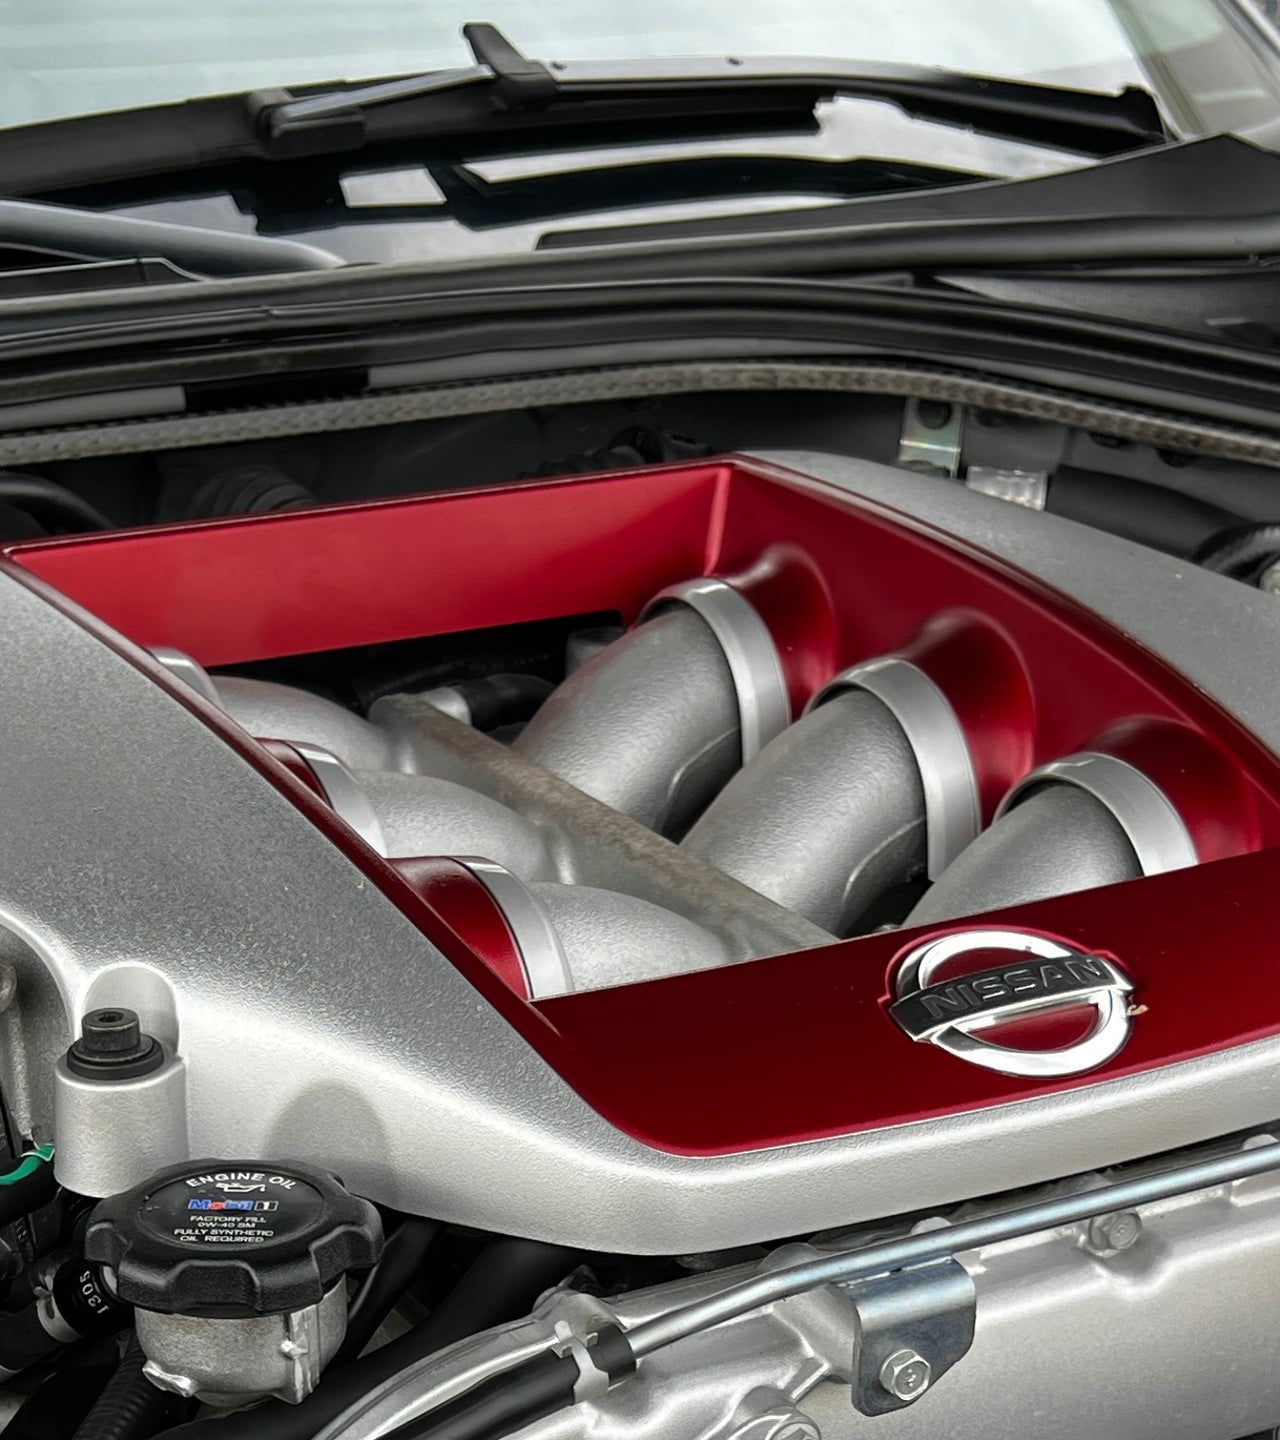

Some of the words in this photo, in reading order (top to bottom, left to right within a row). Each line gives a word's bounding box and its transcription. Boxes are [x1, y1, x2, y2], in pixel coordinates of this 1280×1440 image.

[920, 958, 1103, 1020] NISSAN
[185, 1172, 265, 1188] ENGINE
[268, 1176, 297, 1190] OIL
[245, 1215, 267, 1223] FILL
[210, 1228, 274, 1237] SYNTHETIC
